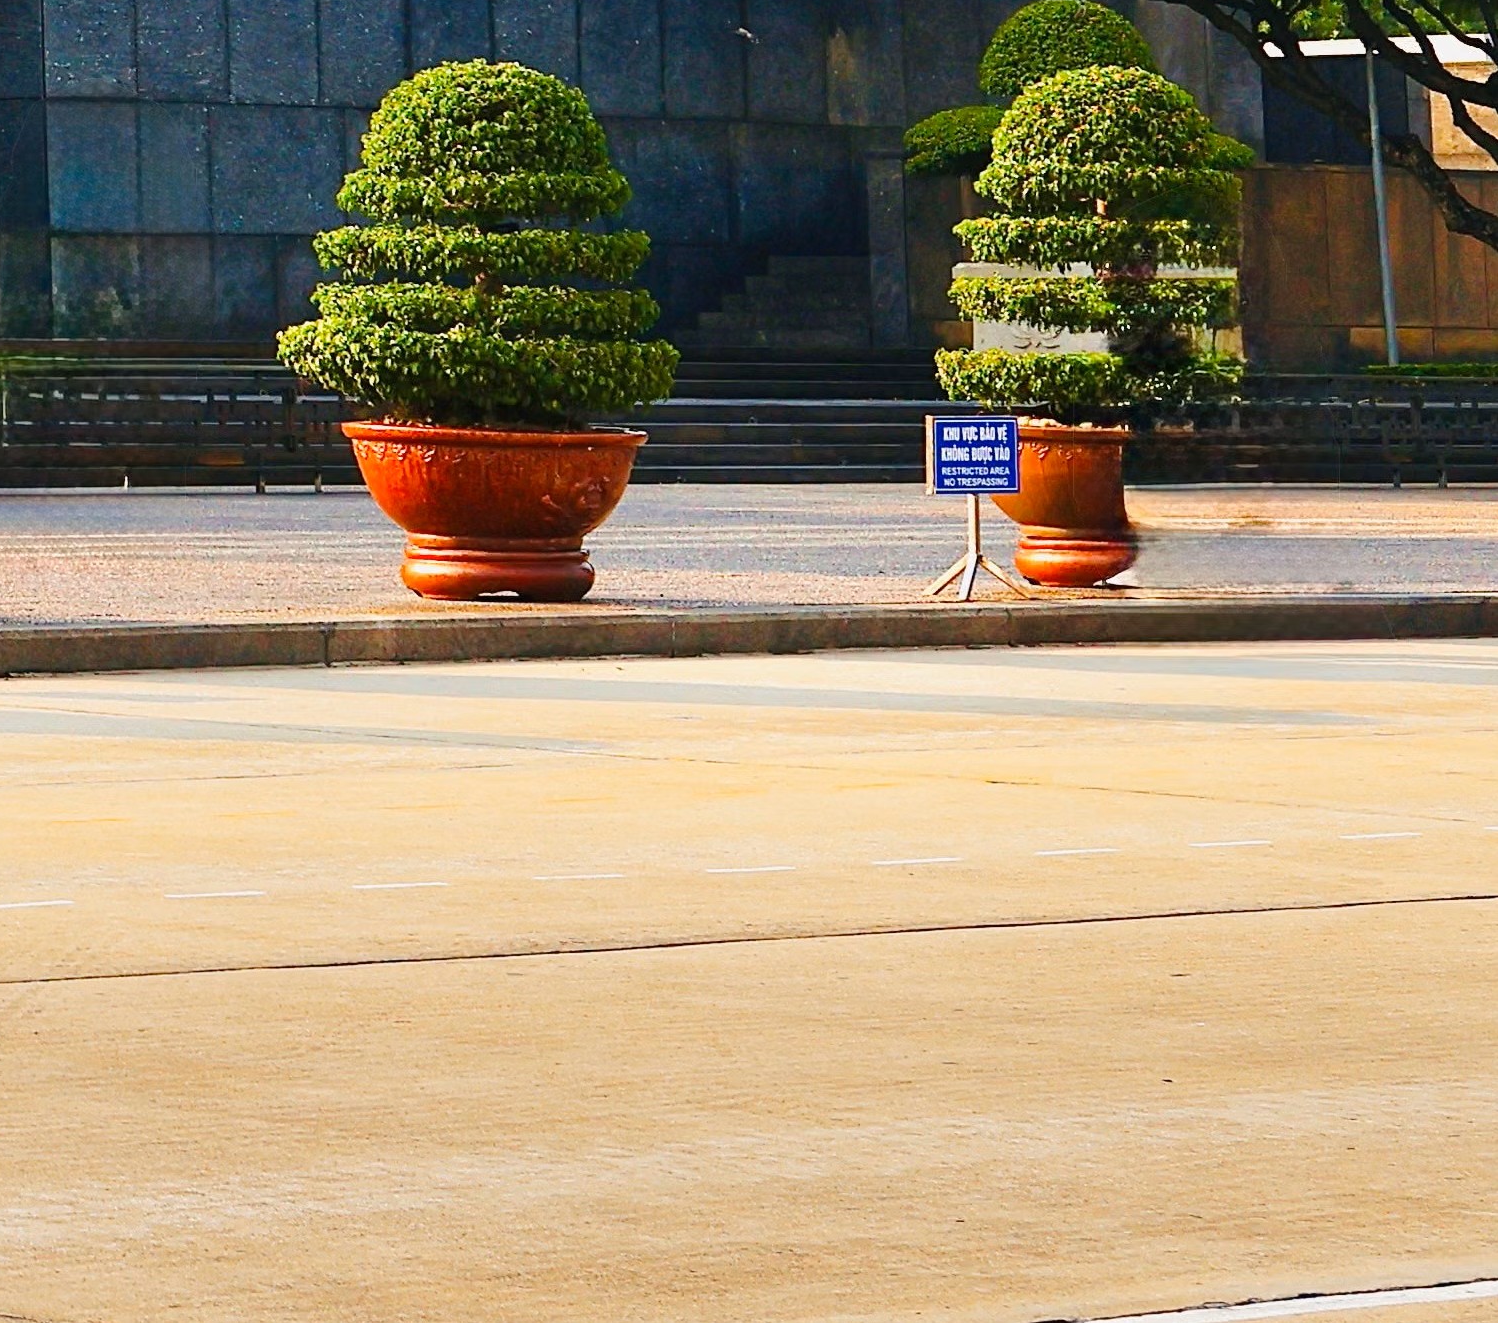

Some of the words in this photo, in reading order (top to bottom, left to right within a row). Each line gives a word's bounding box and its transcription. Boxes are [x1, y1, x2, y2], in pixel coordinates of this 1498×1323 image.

[943, 426, 960, 441] KHU
[941, 466, 989, 475] RESTRICTED
[989, 466, 1010, 475] AREA
[943, 478, 956, 486] NO
[957, 477, 1009, 486] TRESPASSING
